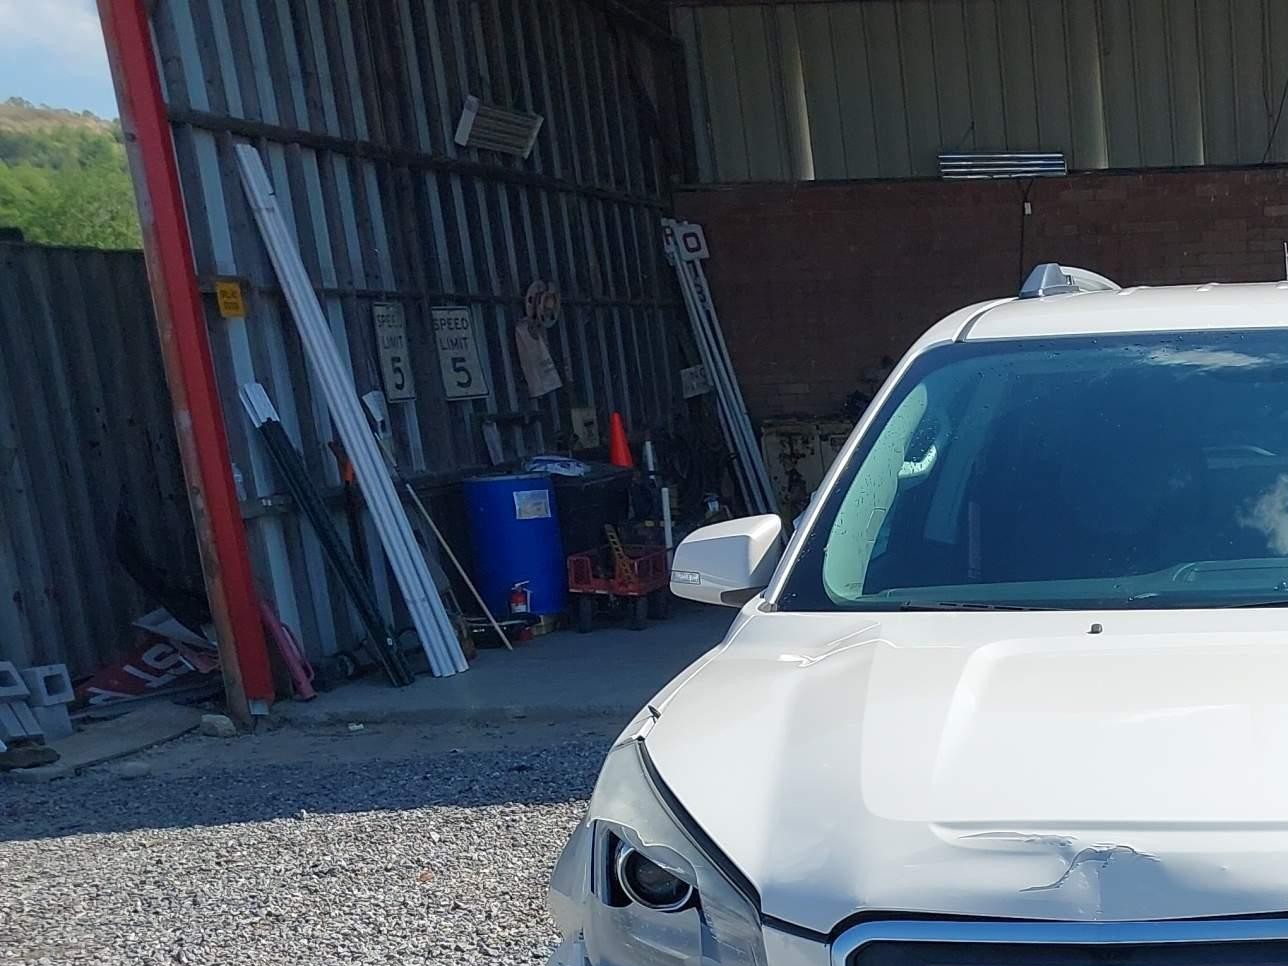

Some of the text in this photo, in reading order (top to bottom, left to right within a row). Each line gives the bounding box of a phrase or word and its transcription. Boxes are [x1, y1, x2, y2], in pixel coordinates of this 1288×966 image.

[433, 317, 470, 331] SPEED
[383, 335, 405, 350] LIMIT
[440, 336, 470, 351] LIMIT
[391, 355, 406, 391] 5
[450, 356, 473, 389] 5
